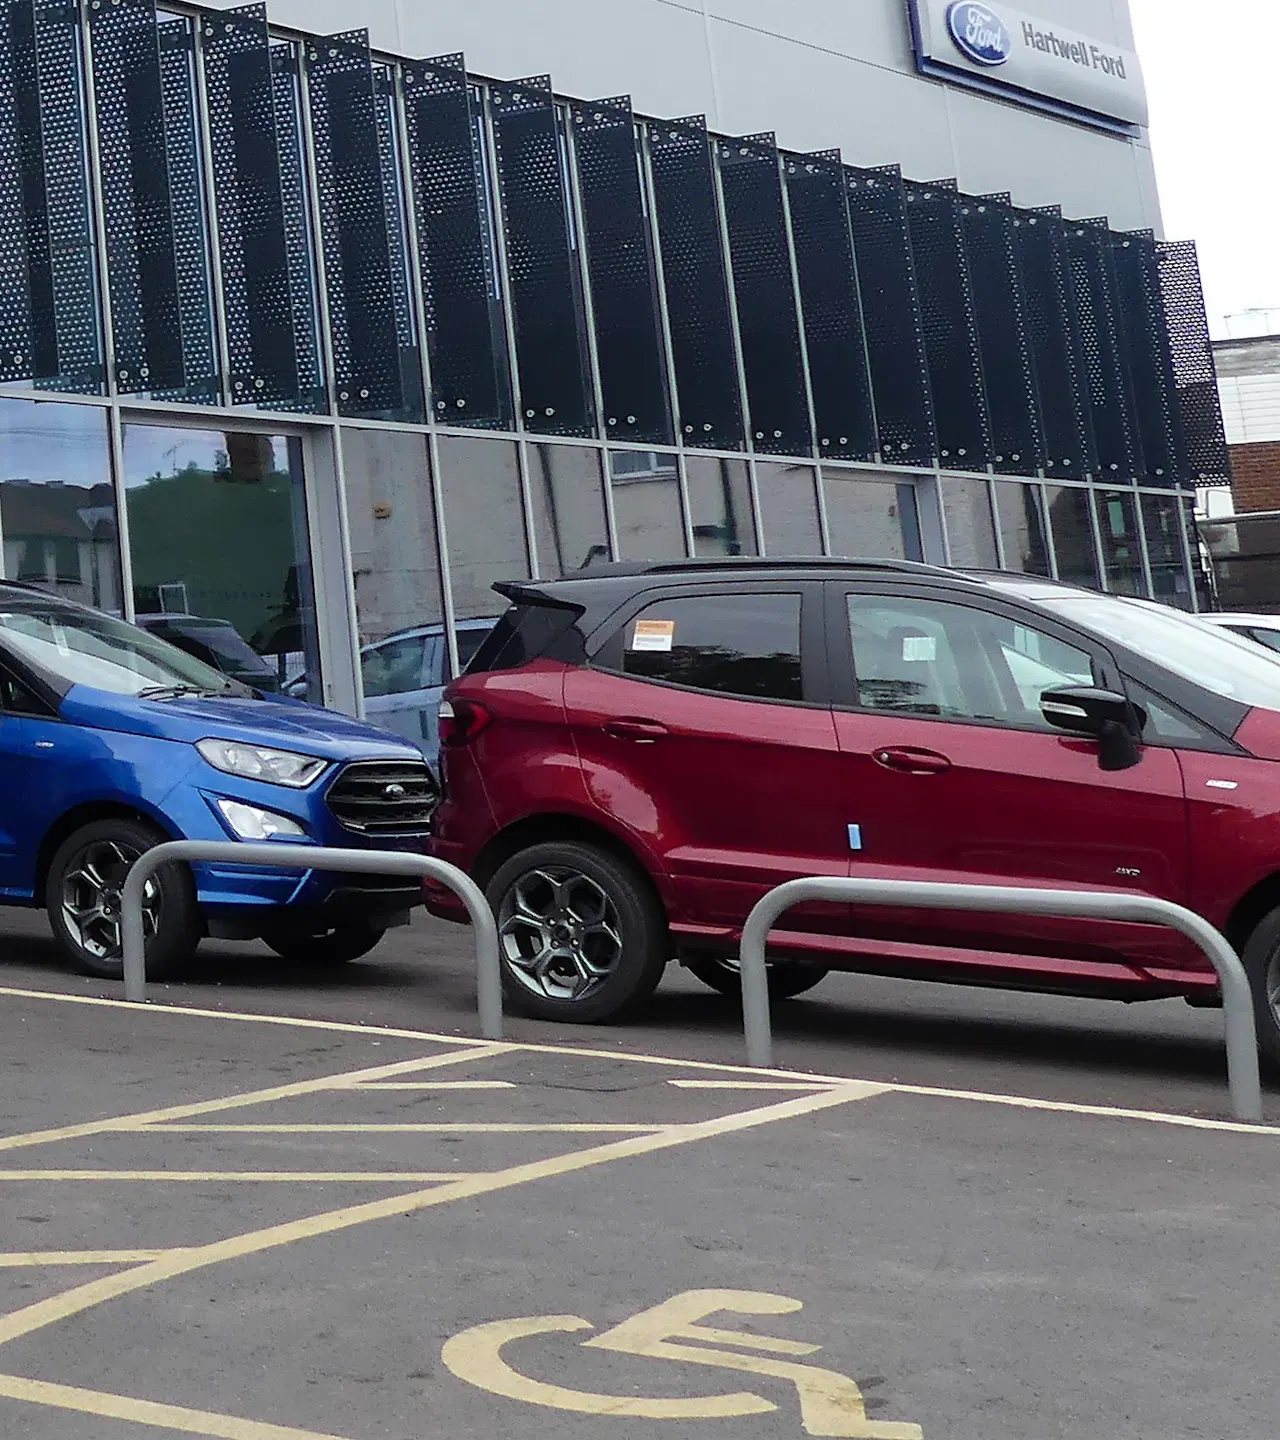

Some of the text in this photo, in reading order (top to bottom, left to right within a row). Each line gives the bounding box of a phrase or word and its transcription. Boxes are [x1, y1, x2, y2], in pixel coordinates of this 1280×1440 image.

[965, 6, 1004, 53] Ford
[1021, 20, 1127, 79] Hartwell Ford
